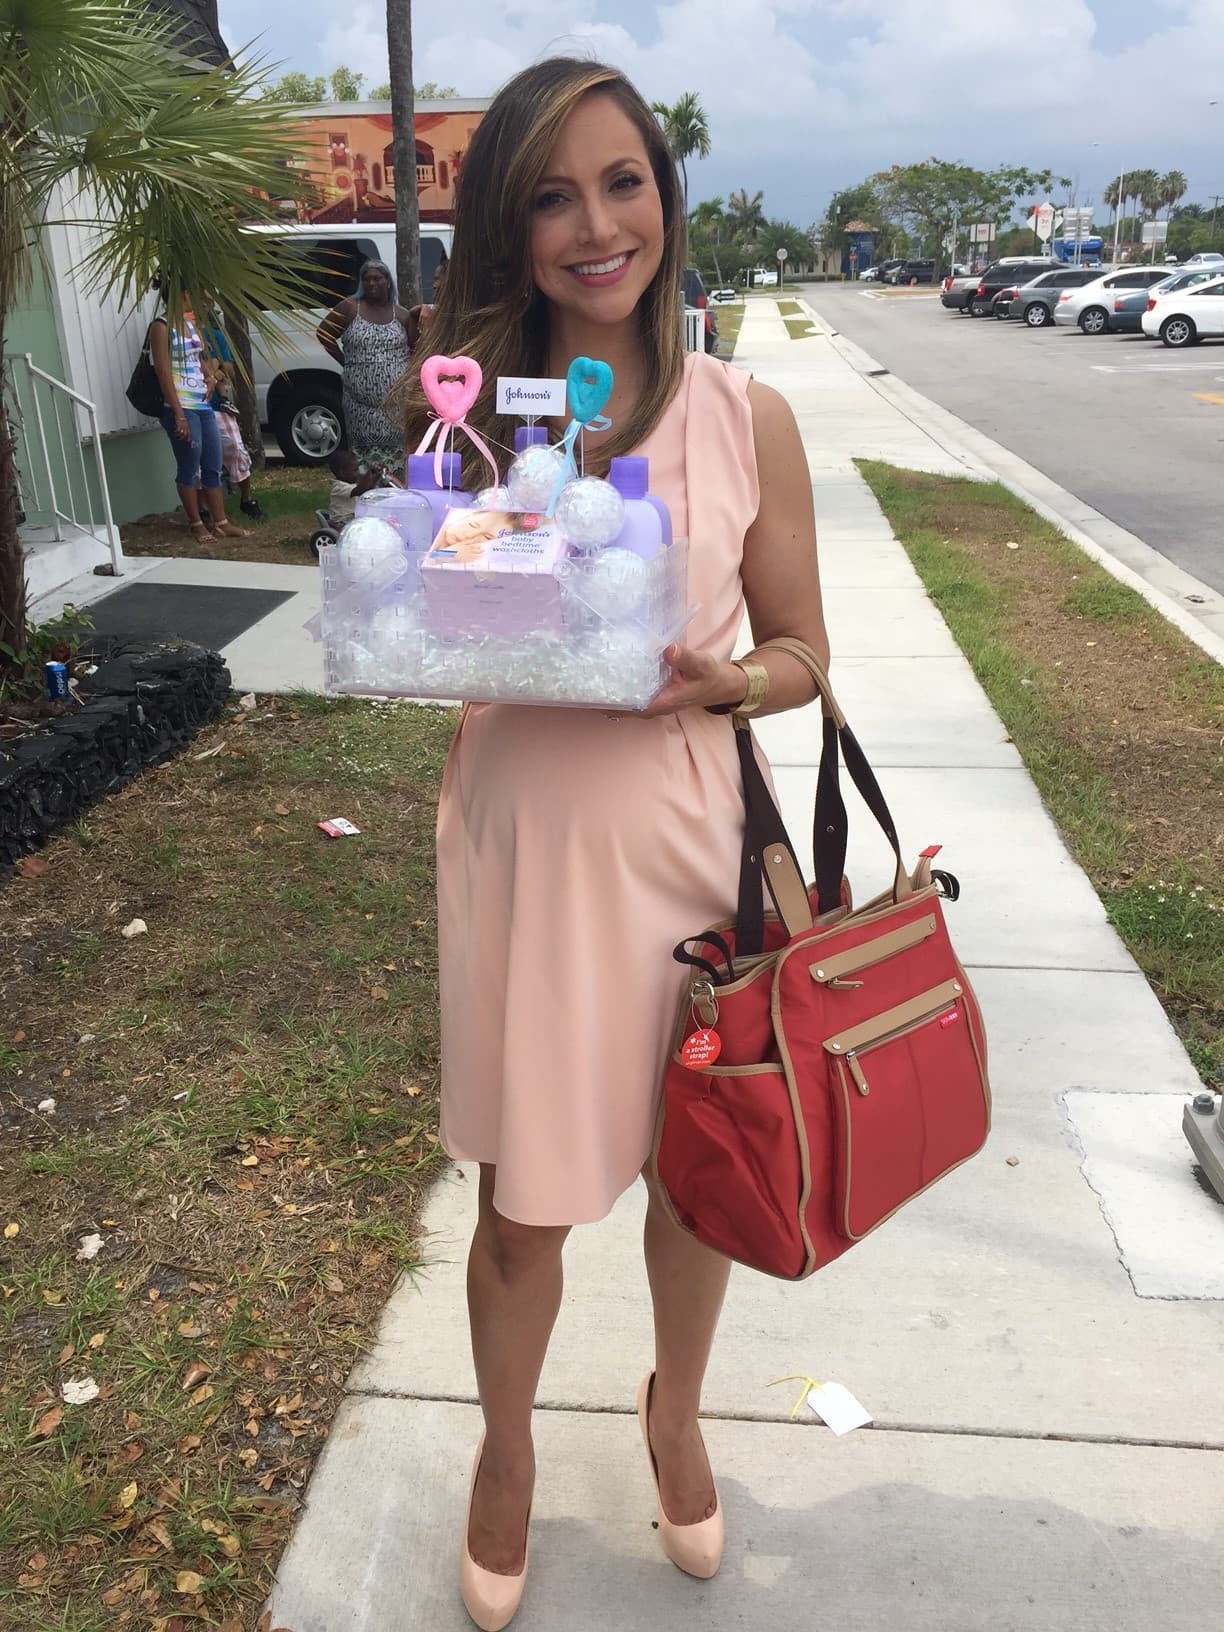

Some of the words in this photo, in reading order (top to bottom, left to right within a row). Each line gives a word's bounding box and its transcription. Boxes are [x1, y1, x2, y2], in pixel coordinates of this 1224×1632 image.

[505, 386, 552, 405] Johnson's
[497, 528, 551, 539] Johnson's
[511, 535, 535, 544] baby
[501, 541, 541, 549] bedtime
[492, 546, 545, 554] washcloths
[691, 1044, 716, 1054] stroller
